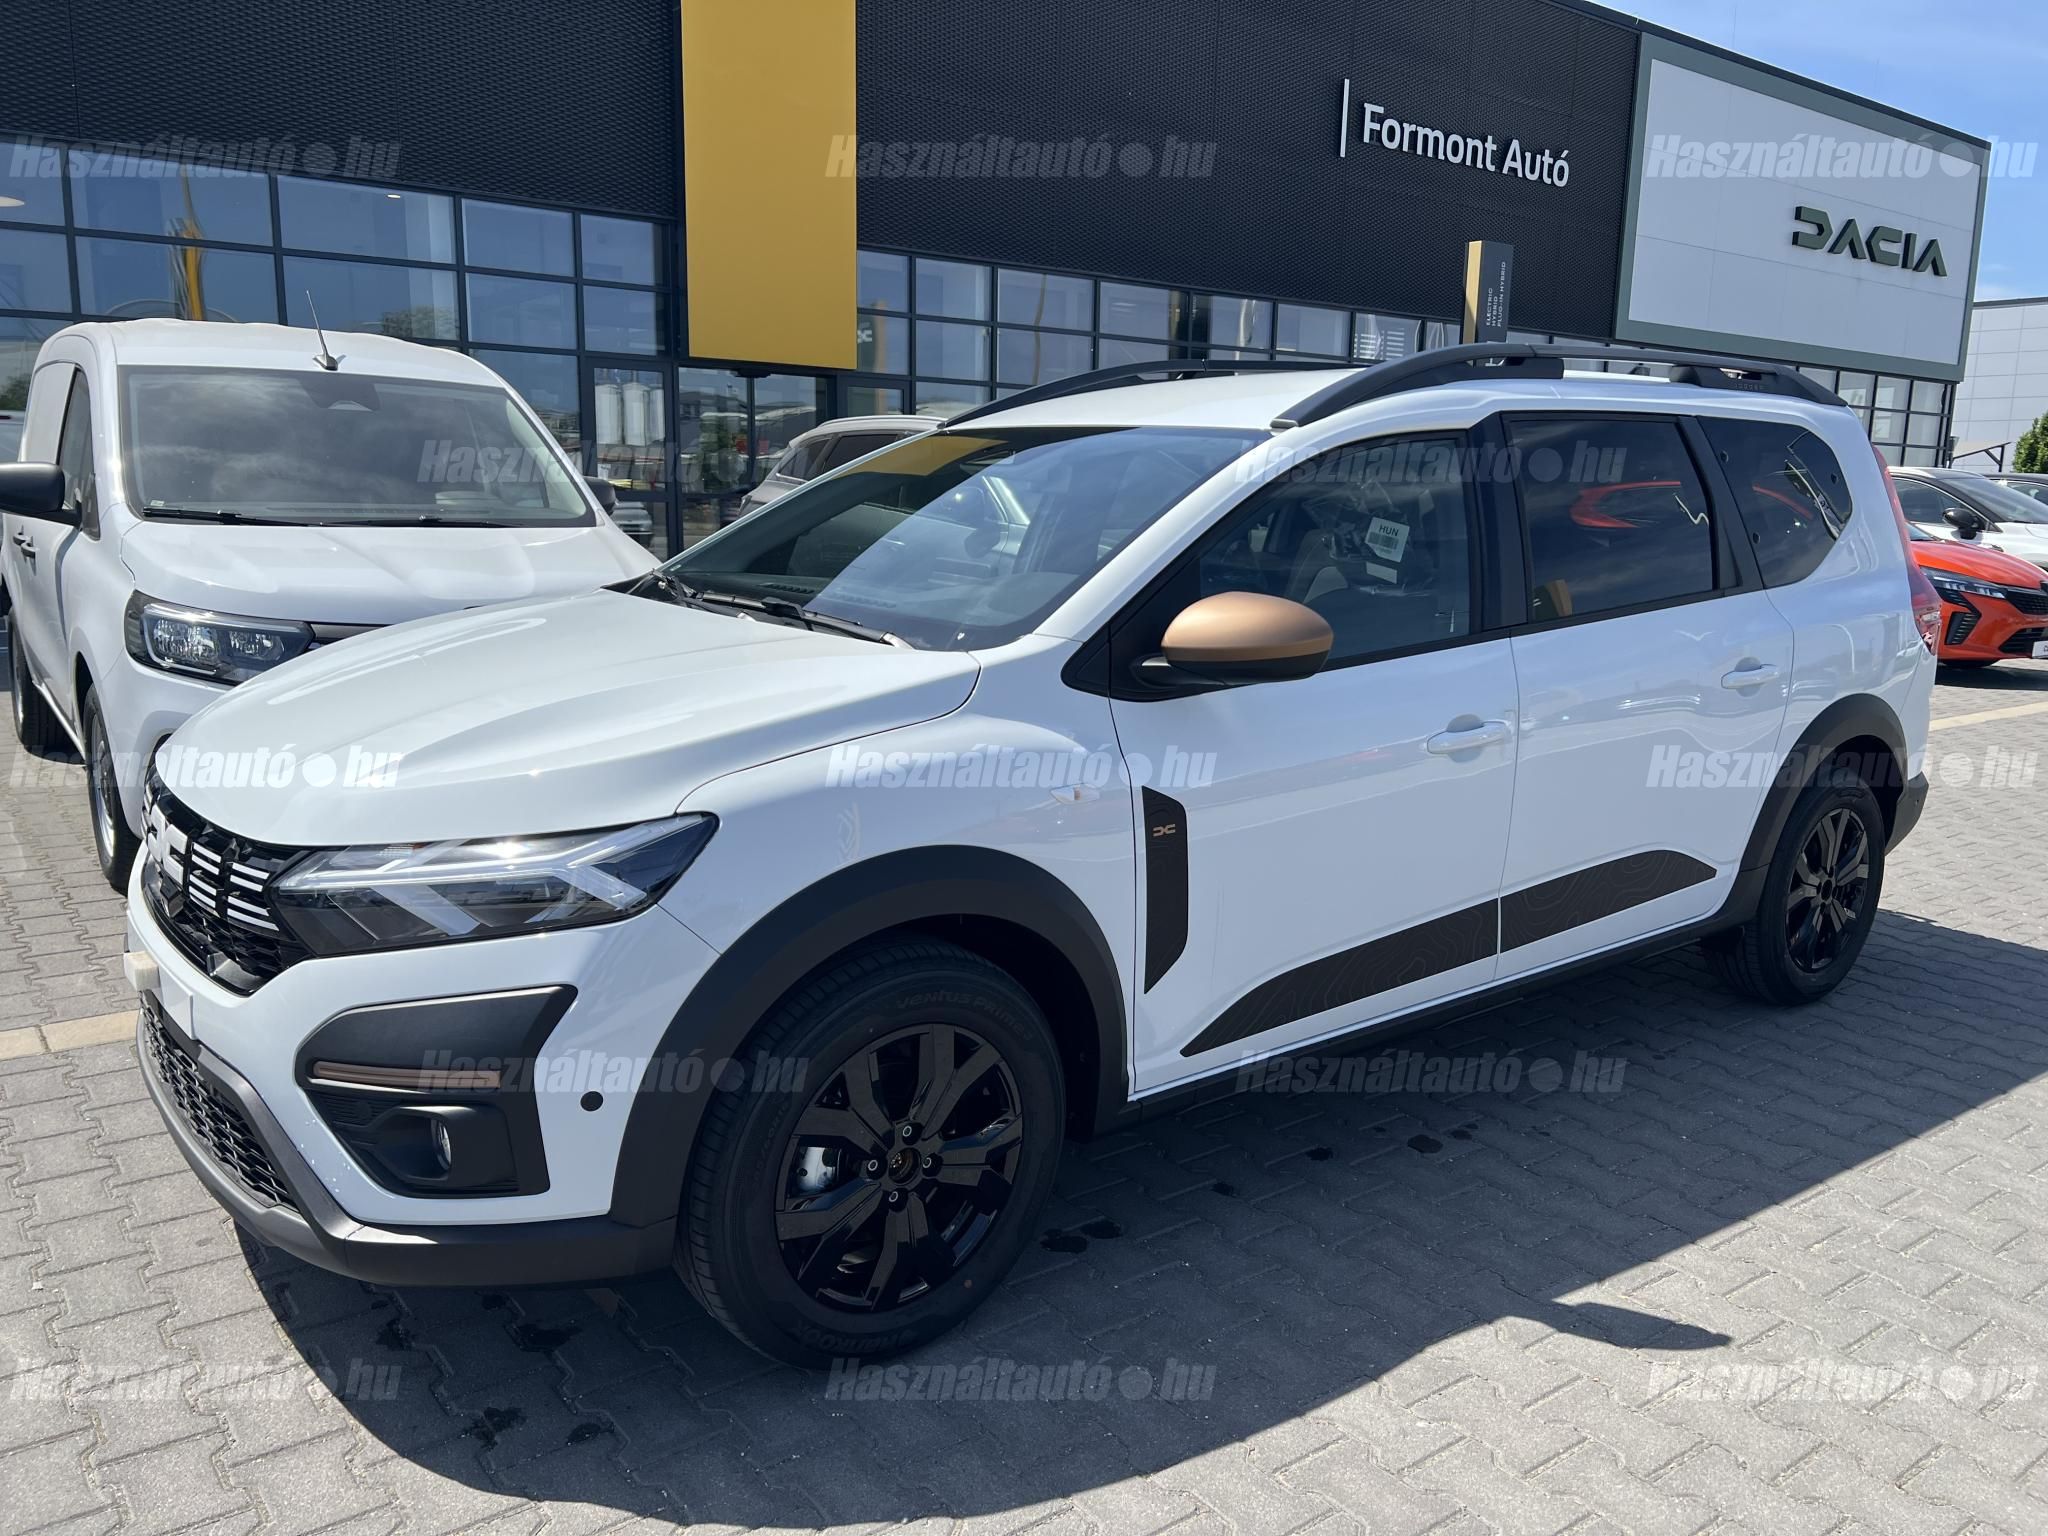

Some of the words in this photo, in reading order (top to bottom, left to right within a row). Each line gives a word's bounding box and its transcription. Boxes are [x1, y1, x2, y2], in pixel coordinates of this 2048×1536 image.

[1363, 103, 1497, 172] Formont
[1502, 139, 1570, 187] Autó
[1792, 206, 1947, 276] DACIA
[1379, 525, 1399, 537] HUN
